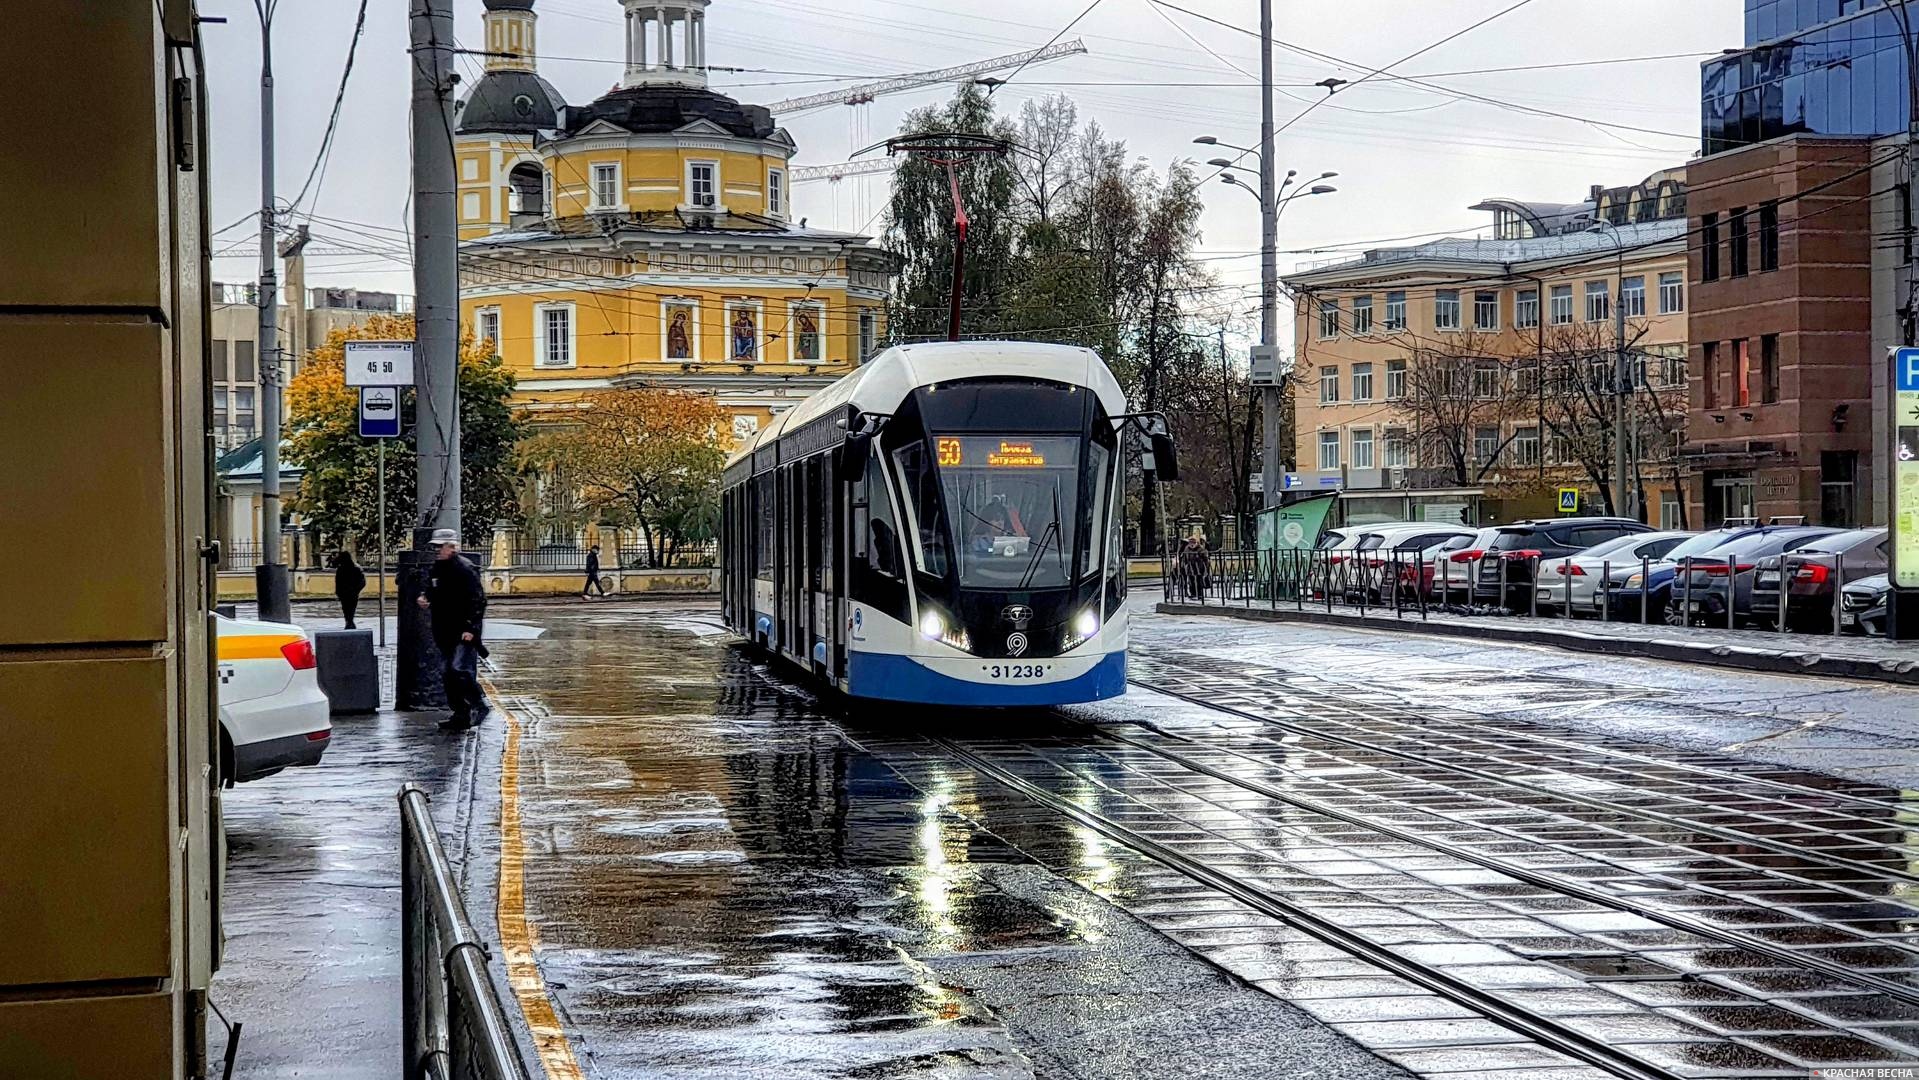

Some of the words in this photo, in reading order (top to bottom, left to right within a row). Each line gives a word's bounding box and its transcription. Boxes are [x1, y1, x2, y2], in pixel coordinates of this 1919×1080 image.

[367, 361, 377, 373] 45
[383, 361, 393, 373] 50
[939, 439, 961, 466] 50
[991, 665, 1044, 678] 31238
